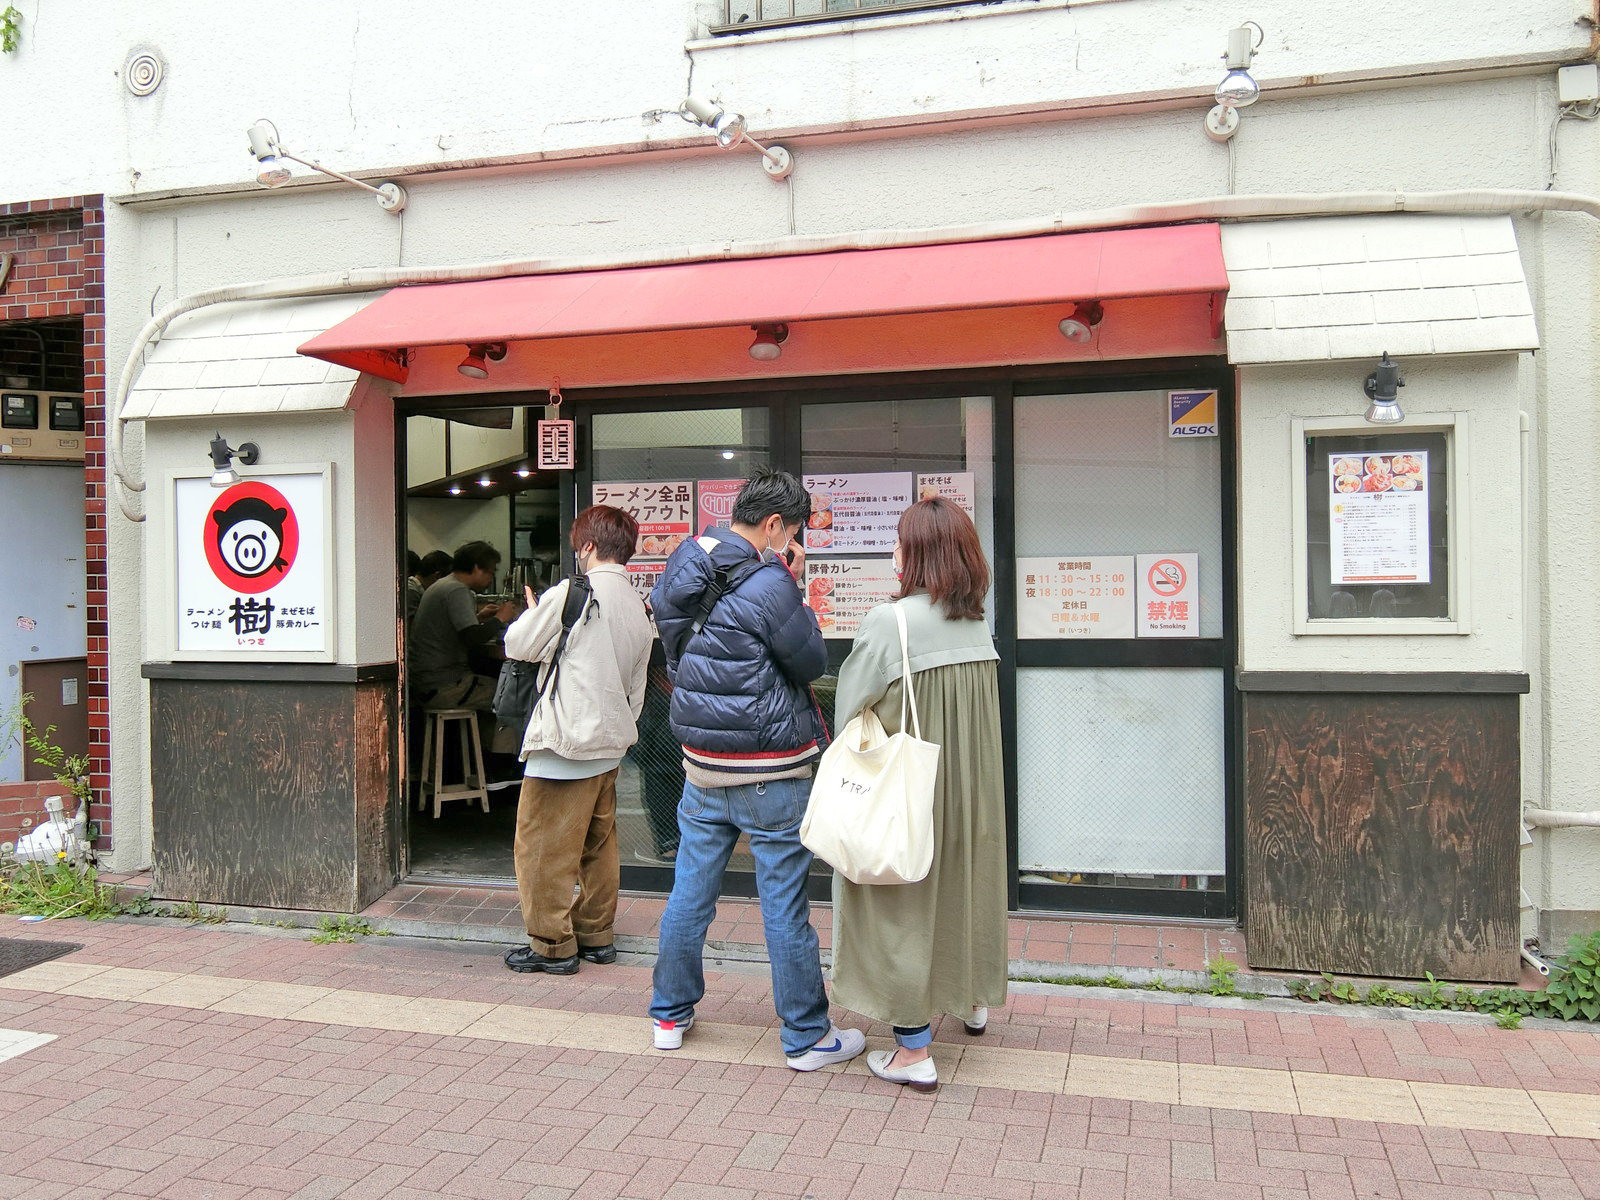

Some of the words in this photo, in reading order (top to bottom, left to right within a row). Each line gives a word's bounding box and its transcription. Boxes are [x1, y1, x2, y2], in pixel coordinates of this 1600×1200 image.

[1172, 426, 1215, 435] ALSOK
[807, 478, 848, 489] ラーメン
[920, 476, 952, 485] まぜそば
[596, 485, 690, 503] ラーメン全品
[809, 564, 861, 574] 豚骨カレー
[1058, 562, 1092, 570] 営業時間
[1026, 575, 1036, 584] 昼
[1026, 588, 1036, 597] 夜
[1062, 601, 1087, 609] 定休日
[187, 608, 225, 616] ラーメン
[281, 606, 315, 615] まぜそば
[1148, 601, 1188, 620] 禁煙
[229, 597, 275, 635] 樹
[191, 621, 222, 629] つけ麺
[276, 620, 320, 628] 豚骨カレー
